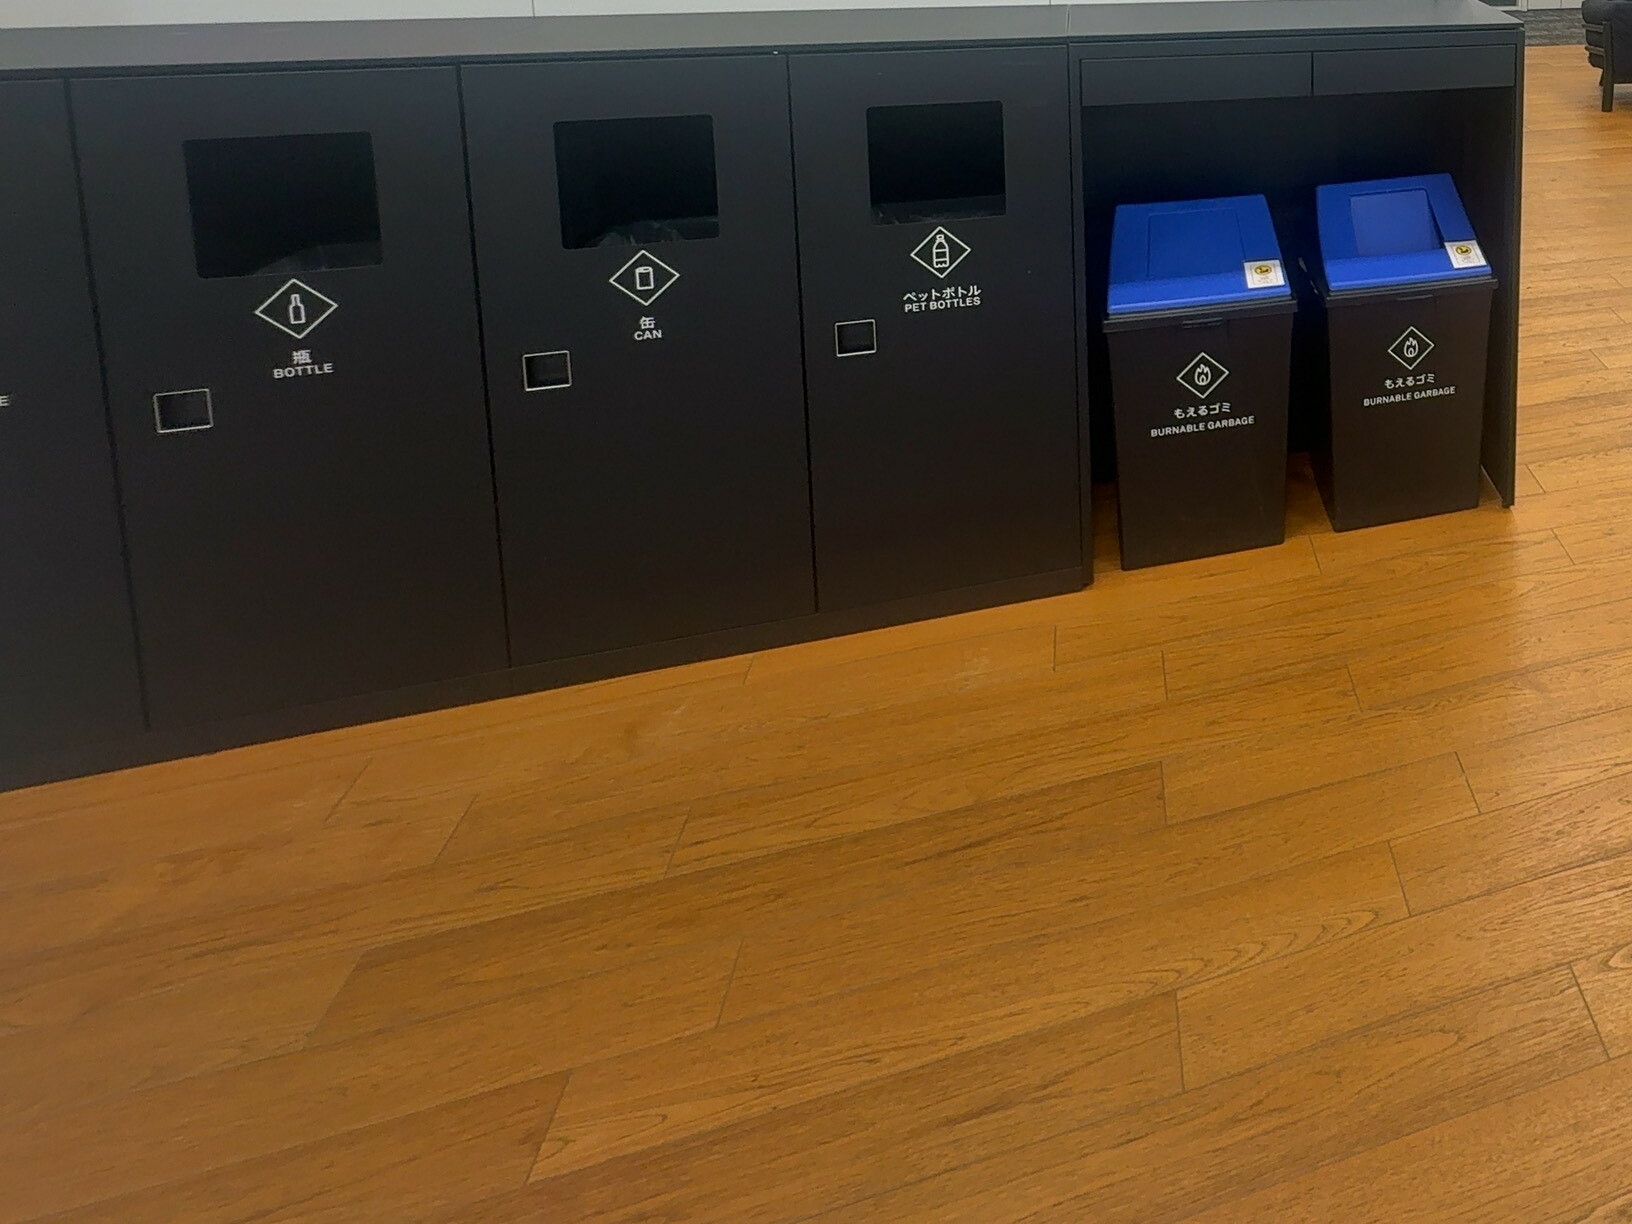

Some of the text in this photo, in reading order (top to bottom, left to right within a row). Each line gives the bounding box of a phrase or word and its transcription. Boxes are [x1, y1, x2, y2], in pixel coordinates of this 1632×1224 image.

[904, 296, 981, 313] PET BOTTLES
[639, 316, 656, 329] 缶
[634, 329, 662, 341] CAN
[273, 362, 335, 379] BOTTLE
[1384, 373, 1435, 389] もえるゴミ
[1363, 386, 1456, 407] BURNABLE GARBAGE
[1173, 402, 1231, 419] もえるゴミ
[1150, 415, 1255, 437] BURNABLE GARBAGE
